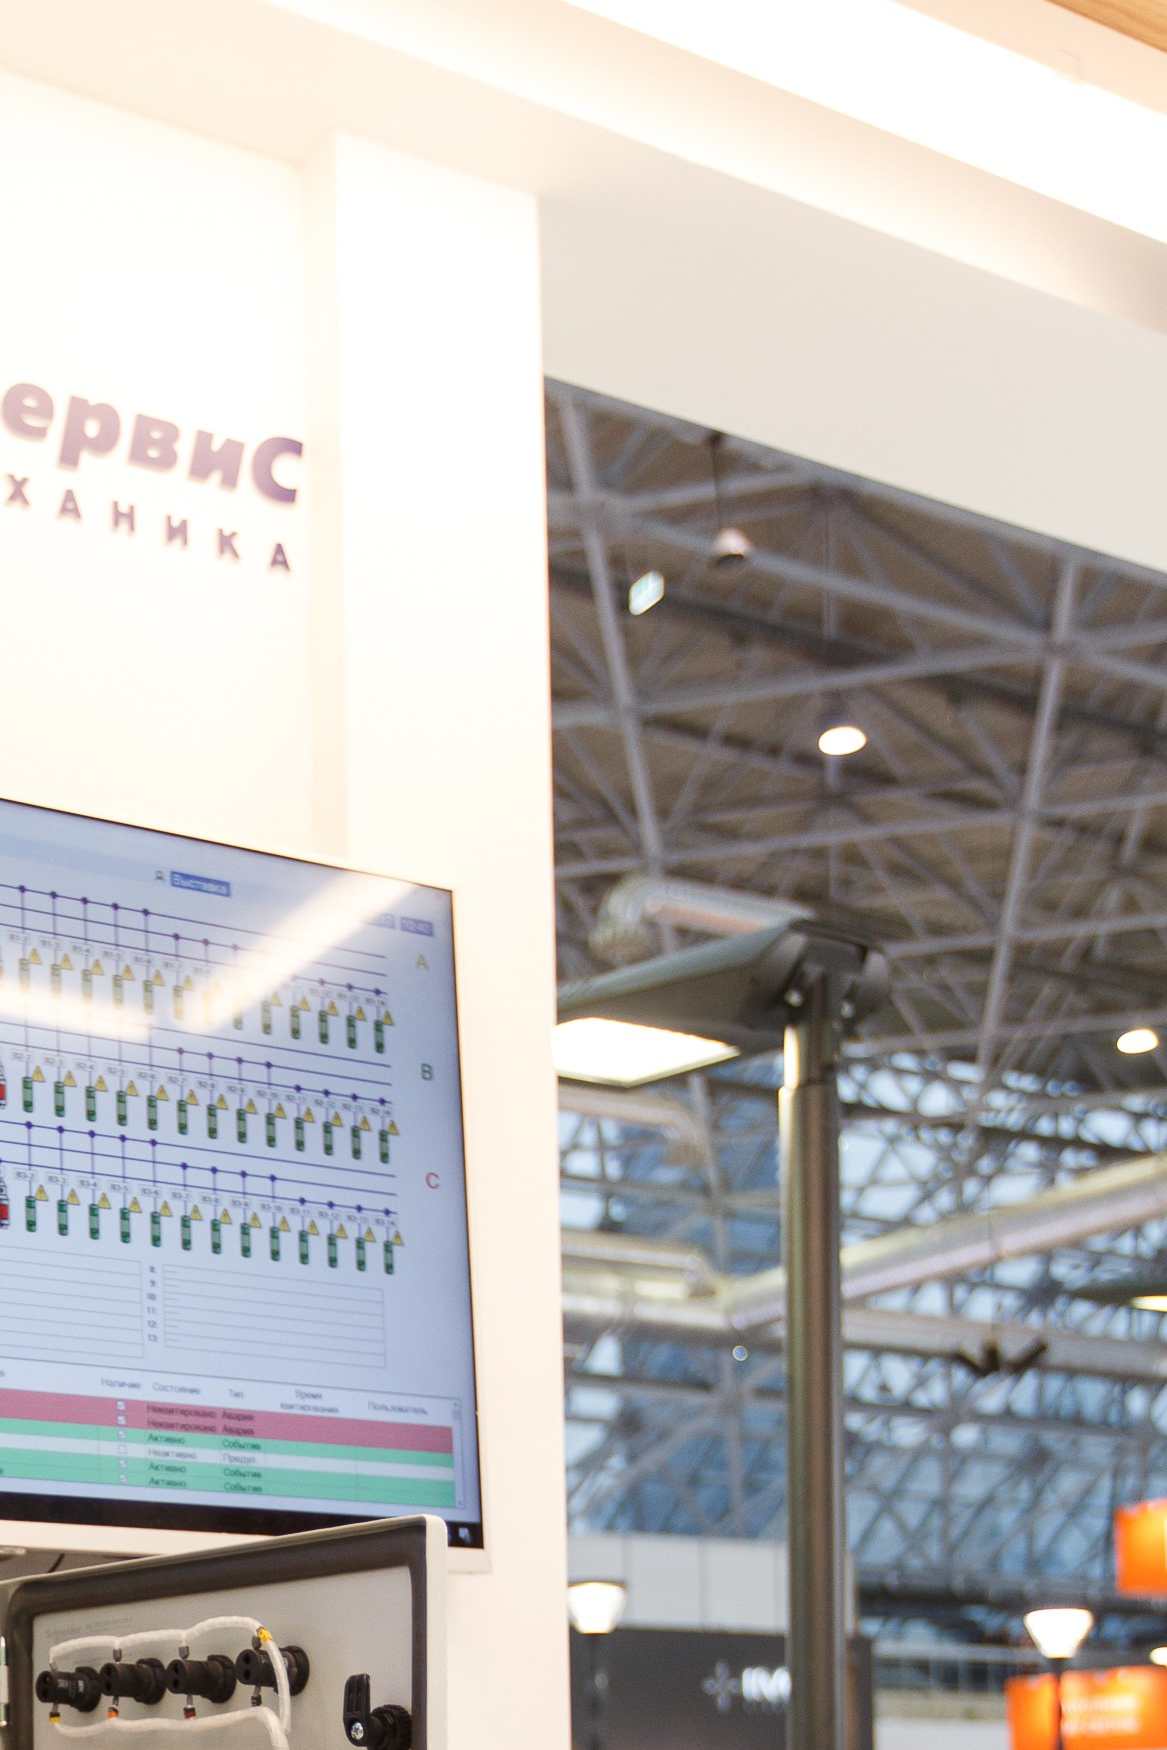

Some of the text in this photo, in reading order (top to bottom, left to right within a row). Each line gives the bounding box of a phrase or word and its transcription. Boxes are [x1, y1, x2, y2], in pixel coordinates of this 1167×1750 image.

[101, 1378, 141, 1391] Наличие
[152, 1382, 201, 1395] Состояние
[228, 1389, 244, 1400] Тип
[295, 1390, 323, 1401] Время
